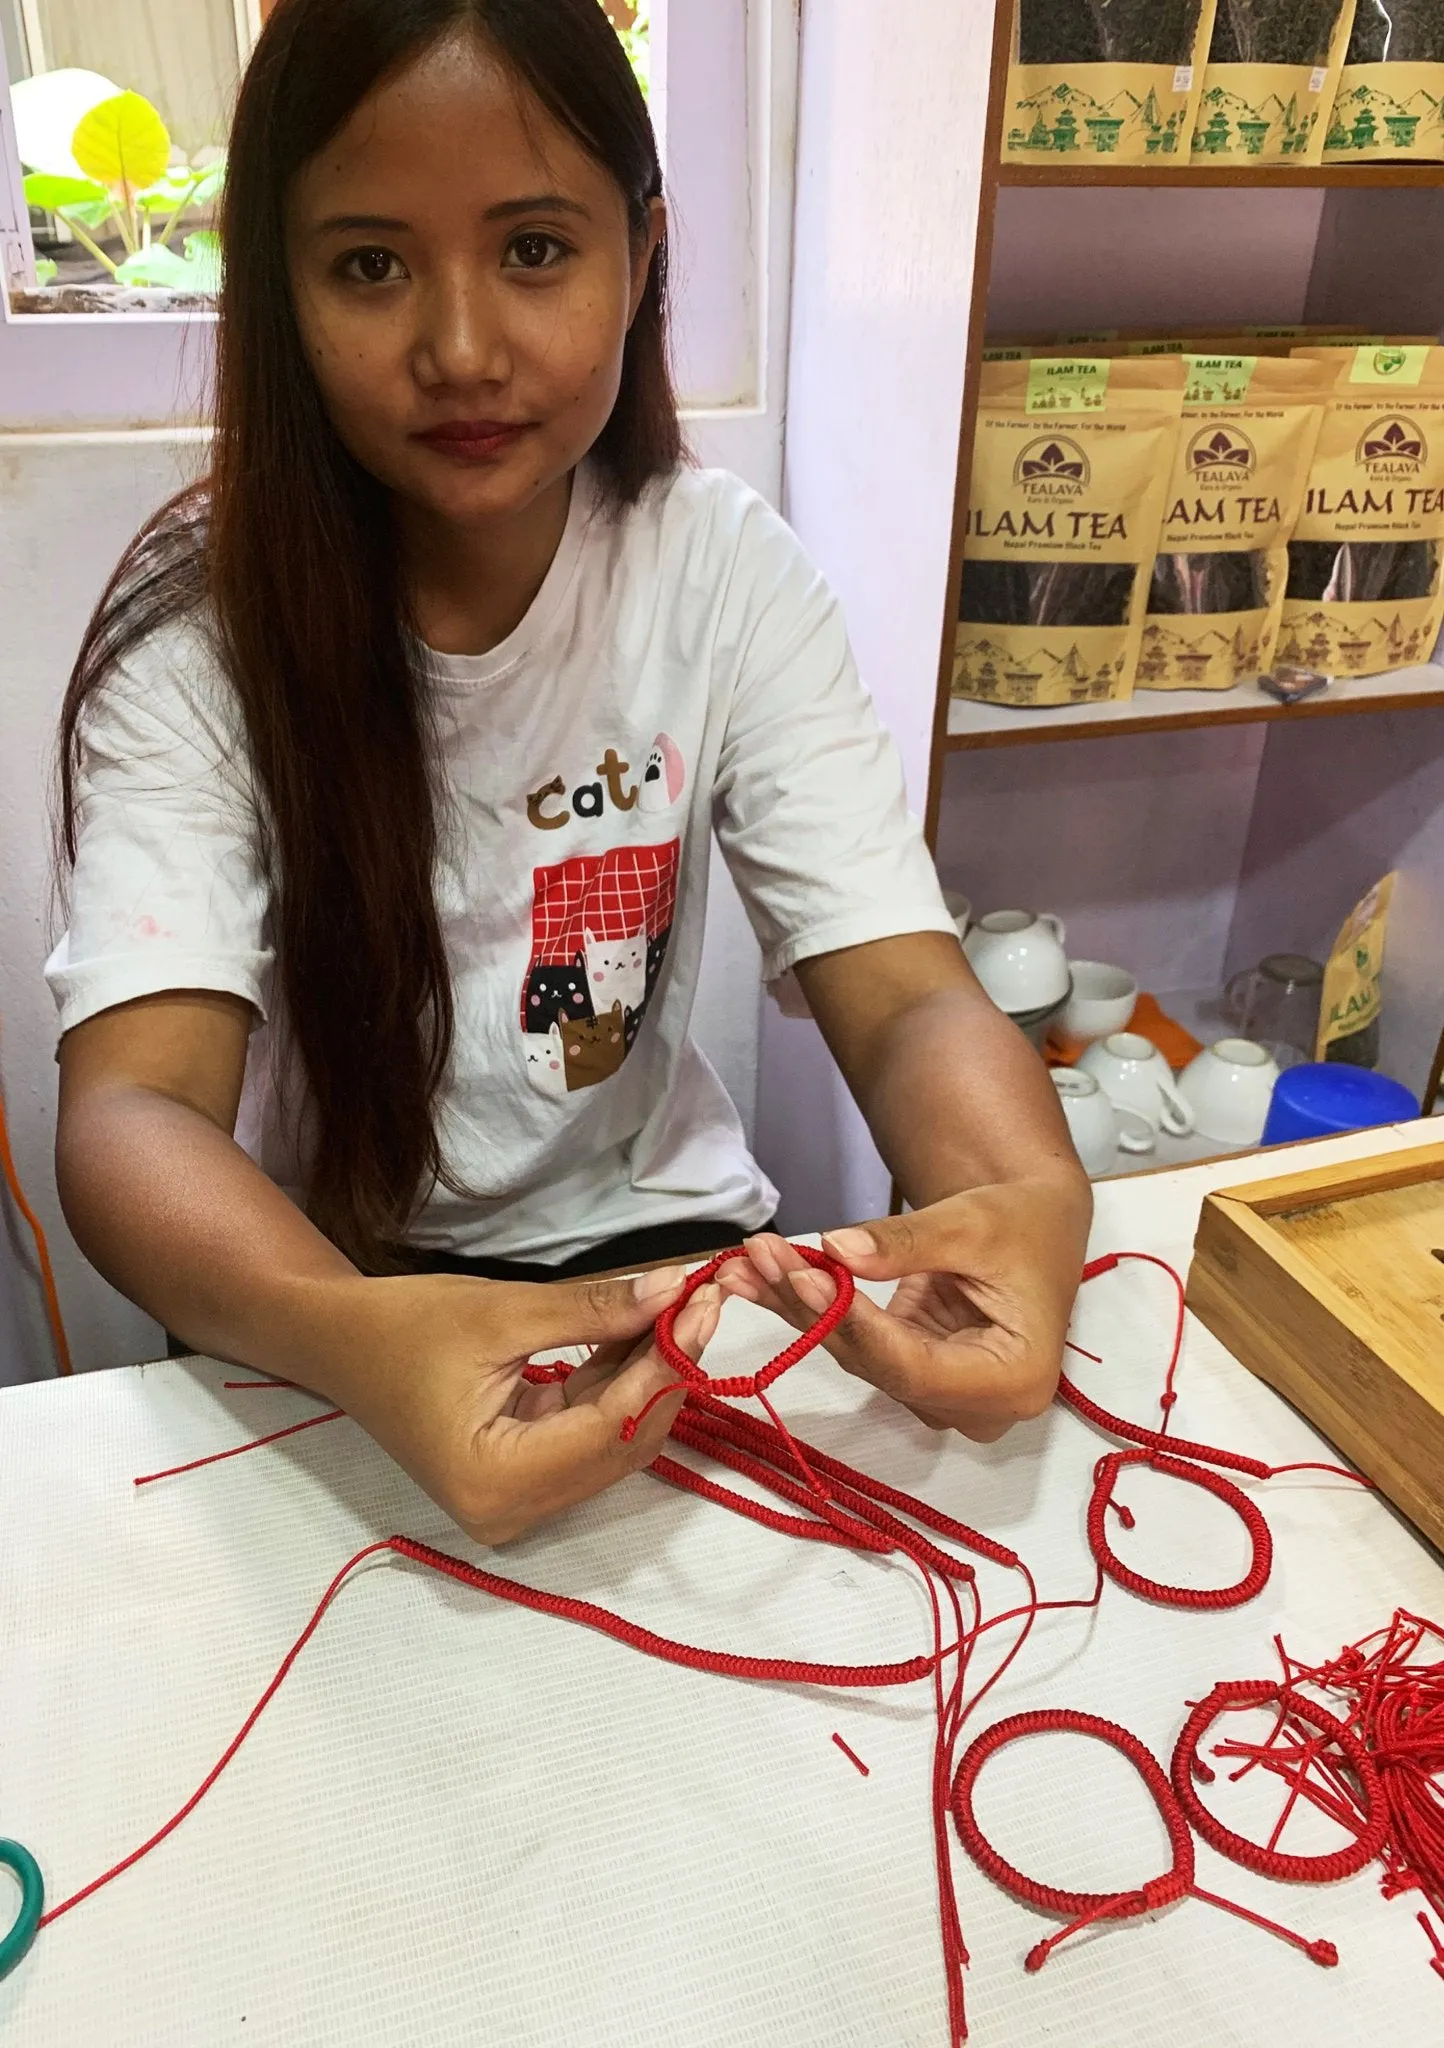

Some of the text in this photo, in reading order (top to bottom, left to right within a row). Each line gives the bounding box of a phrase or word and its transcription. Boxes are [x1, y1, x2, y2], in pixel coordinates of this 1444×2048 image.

[1046, 364, 1097, 376] ILAM TEA
[1195, 360, 1242, 369] ILAM TEA
[1080, 422, 1092, 431] For
[1306, 488, 1444, 514] ILAM TEA
[1162, 497, 1280, 525] AM TEA
[965, 509, 1128, 540] ILAM TEA
[1334, 522, 1357, 531] Nepal
[1358, 522, 1390, 530] Premium
[1410, 520, 1422, 529] Tea
[1166, 533, 1189, 542] Nepal
[1190, 532, 1223, 541] Premium
[1243, 530, 1255, 539] Tea
[1003, 540, 1027, 549] Nepal
[1028, 540, 1064, 550] Premium
[1088, 541, 1102, 551] Tea
[526, 748, 639, 831] cat
